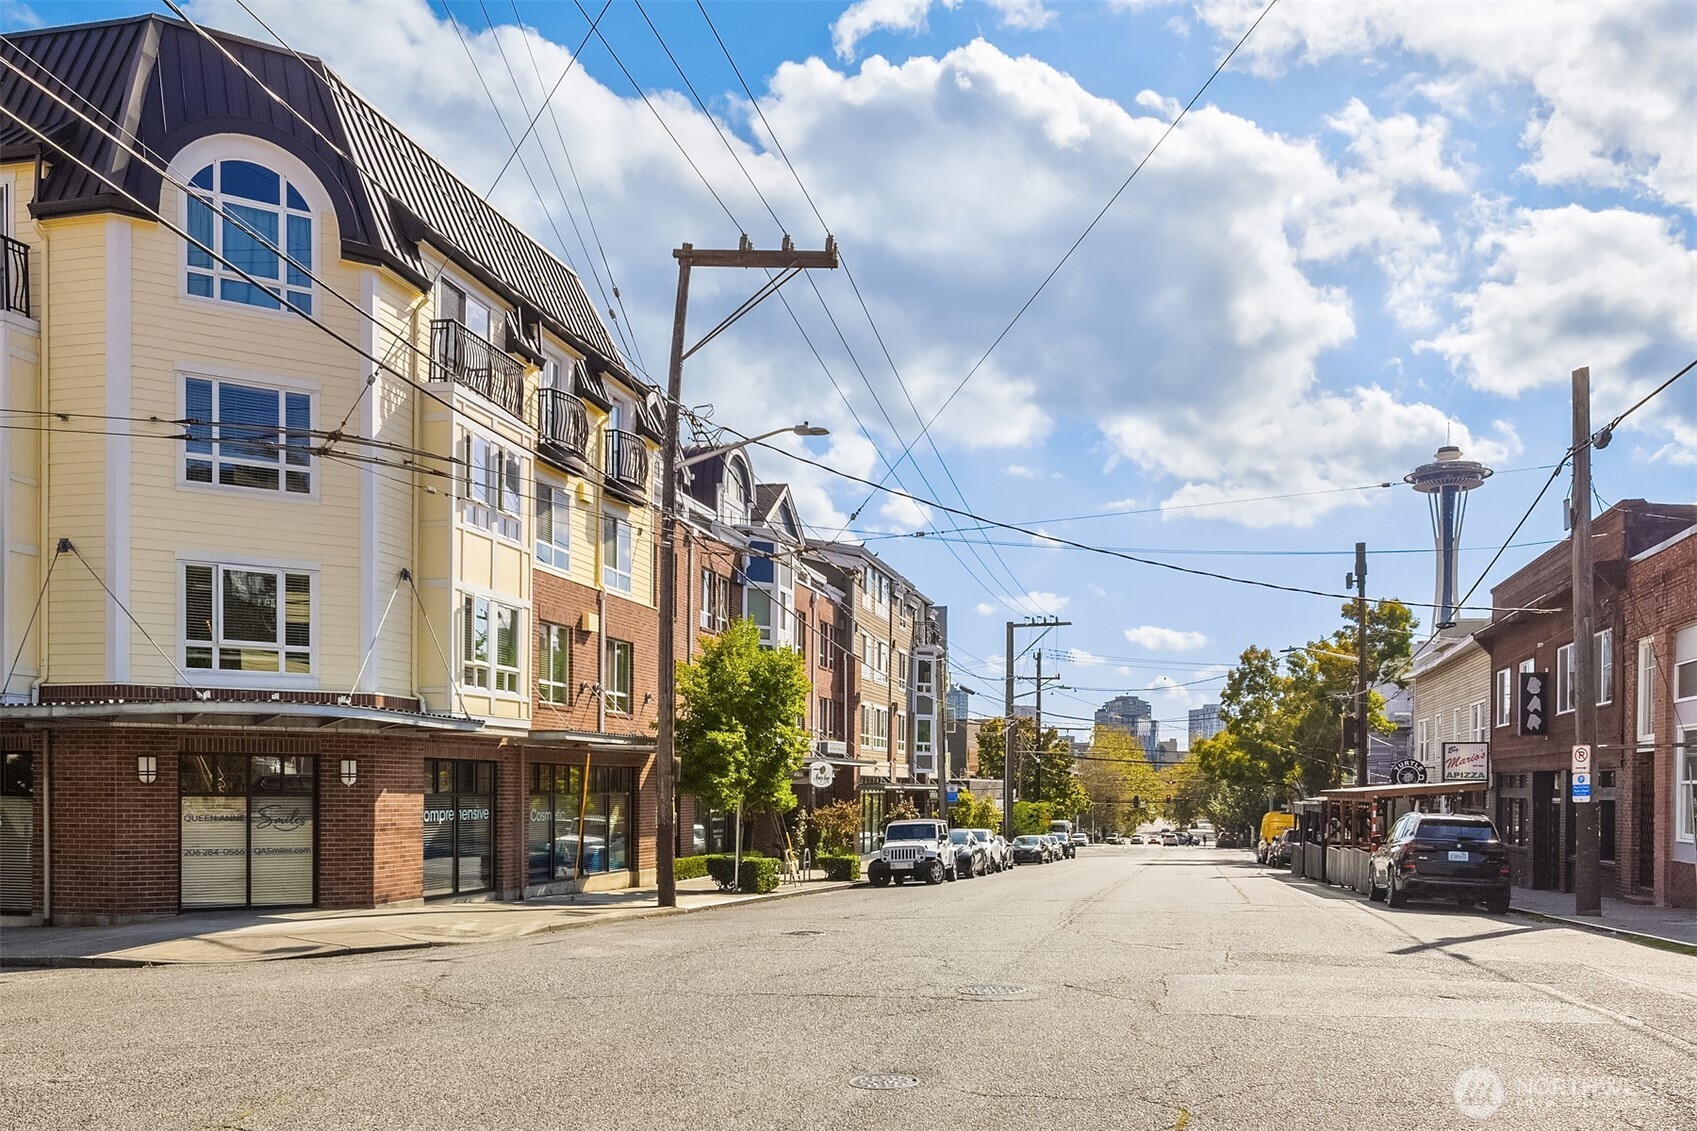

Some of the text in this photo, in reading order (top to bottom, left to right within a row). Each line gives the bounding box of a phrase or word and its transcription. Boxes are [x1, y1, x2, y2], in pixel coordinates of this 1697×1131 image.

[1394, 760, 1424, 772] TURTLE
[1445, 748, 1486, 769] Mario's
[257, 805, 306, 829] Smiles
[423, 808, 489, 825] ompreensive
[530, 808, 565, 822] Cosmtic
[253, 847, 311, 855] QASmiles.com
